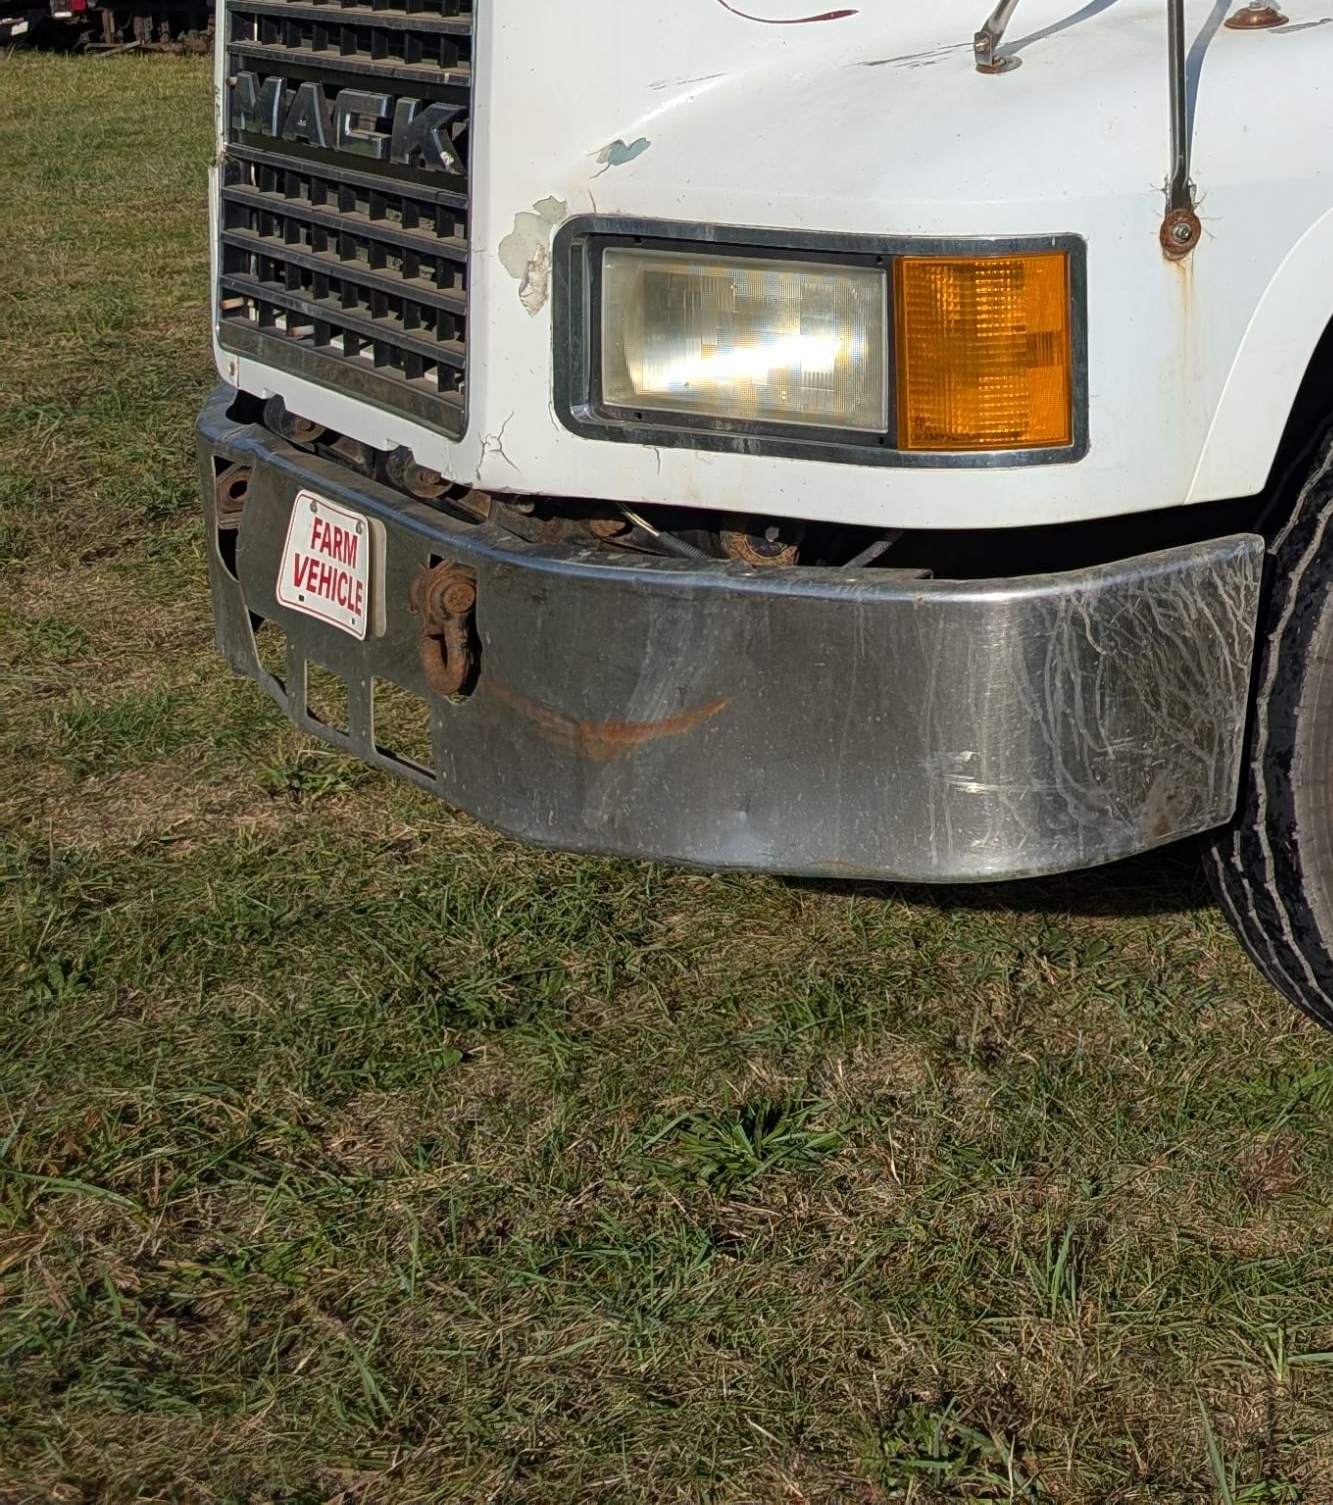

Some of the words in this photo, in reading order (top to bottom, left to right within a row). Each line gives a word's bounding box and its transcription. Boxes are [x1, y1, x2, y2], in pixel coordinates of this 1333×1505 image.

[231, 70, 468, 176] MACK
[310, 516, 358, 569] FARM
[293, 552, 364, 616] VEHICLE
